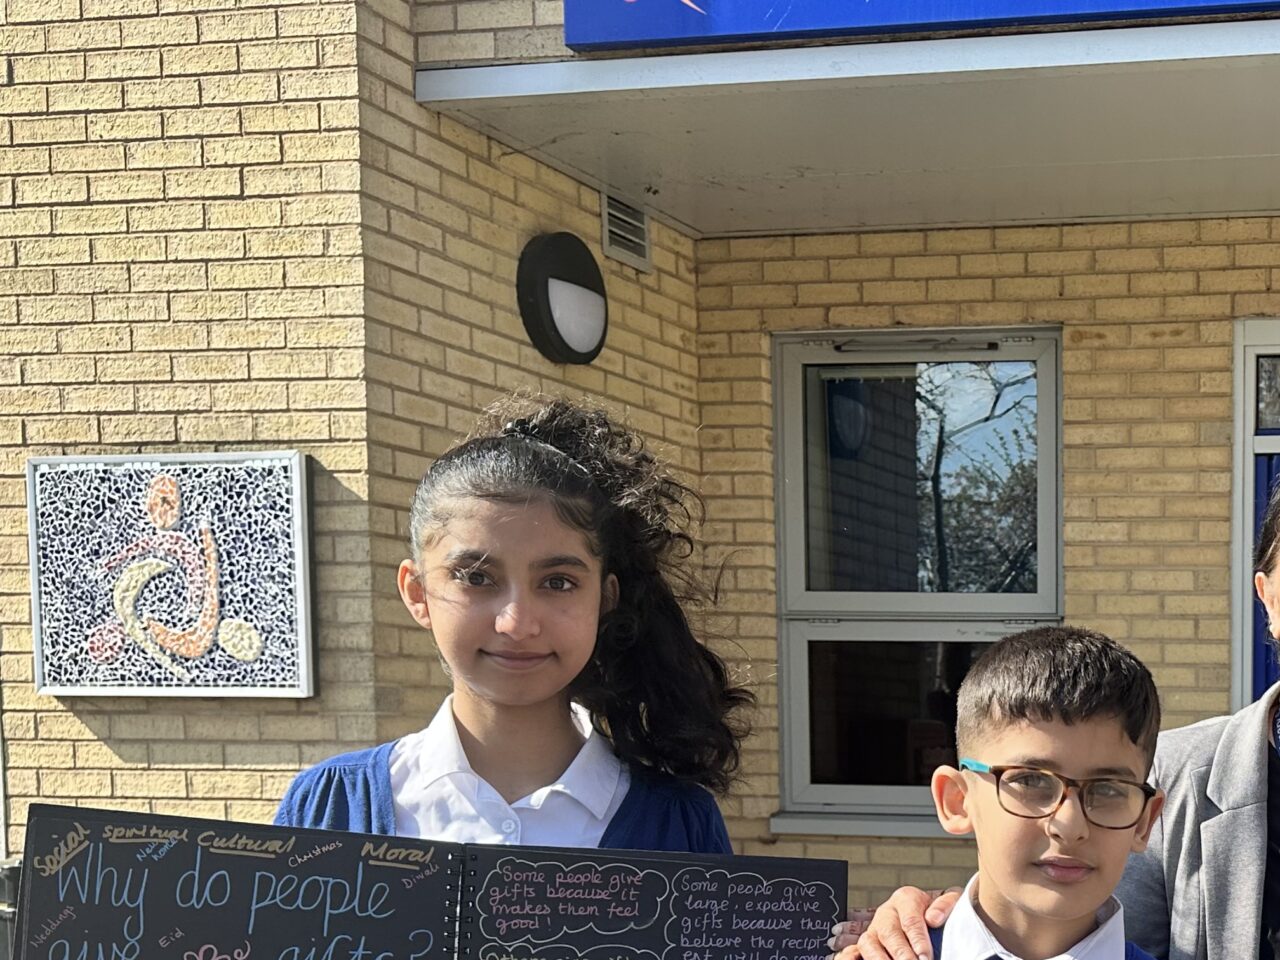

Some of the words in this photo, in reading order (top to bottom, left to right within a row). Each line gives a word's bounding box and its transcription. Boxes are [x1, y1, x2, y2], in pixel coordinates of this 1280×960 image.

[197, 831, 296, 853] Cultural
[361, 841, 434, 863] Moral
[289, 840, 343, 868] Christmas
[503, 866, 545, 883] Some
[556, 869, 602, 887] people
[610, 873, 643, 893] give
[58, 842, 149, 941] Why
[176, 845, 230, 909] do
[248, 861, 396, 937] people
[489, 883, 536, 905] gifts
[547, 884, 612, 900] because
[622, 887, 640, 901] it
[492, 901, 551, 915] makes
[558, 903, 599, 915] them
[607, 902, 639, 918] feel
[158, 927, 185, 949] Eid
